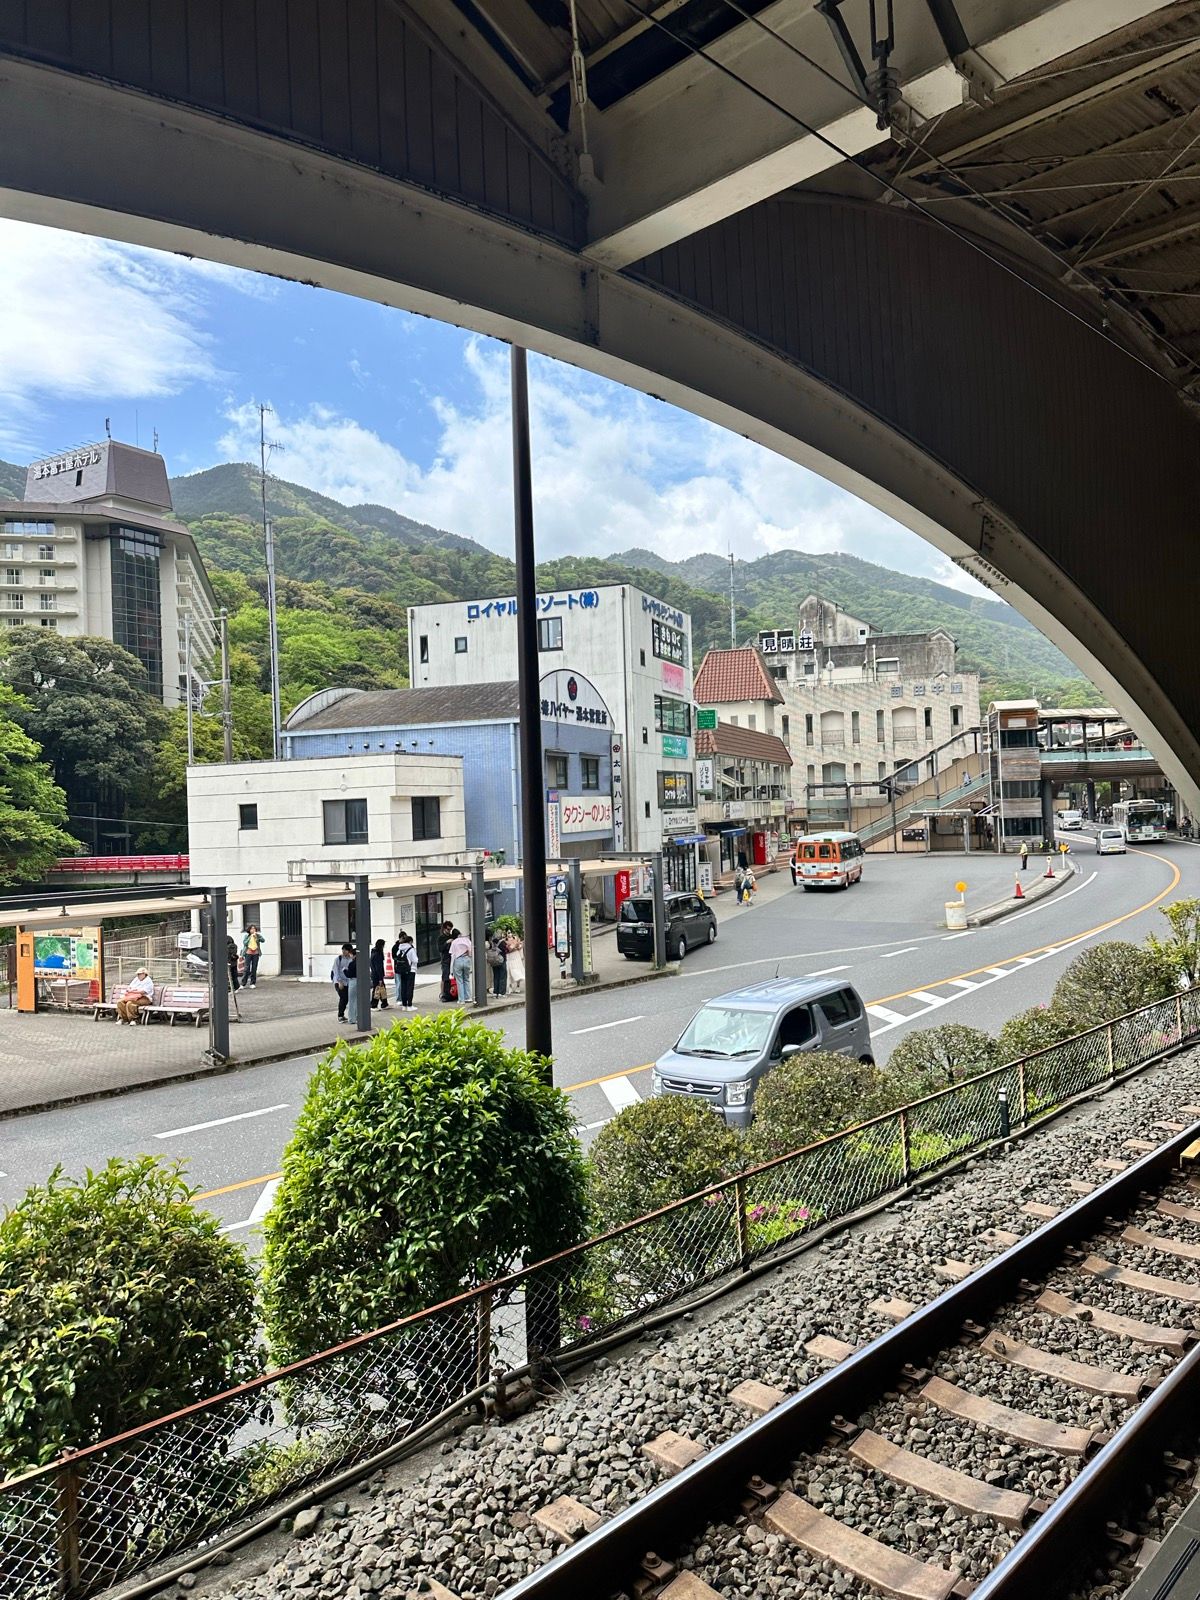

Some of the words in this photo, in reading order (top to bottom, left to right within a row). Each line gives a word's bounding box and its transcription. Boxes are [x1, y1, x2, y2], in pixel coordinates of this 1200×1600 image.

[33, 450, 98, 480] 湯本富士屋ホテル
[764, 636, 813, 652] 見晴荘
[564, 804, 611, 824] タクシーのりば
